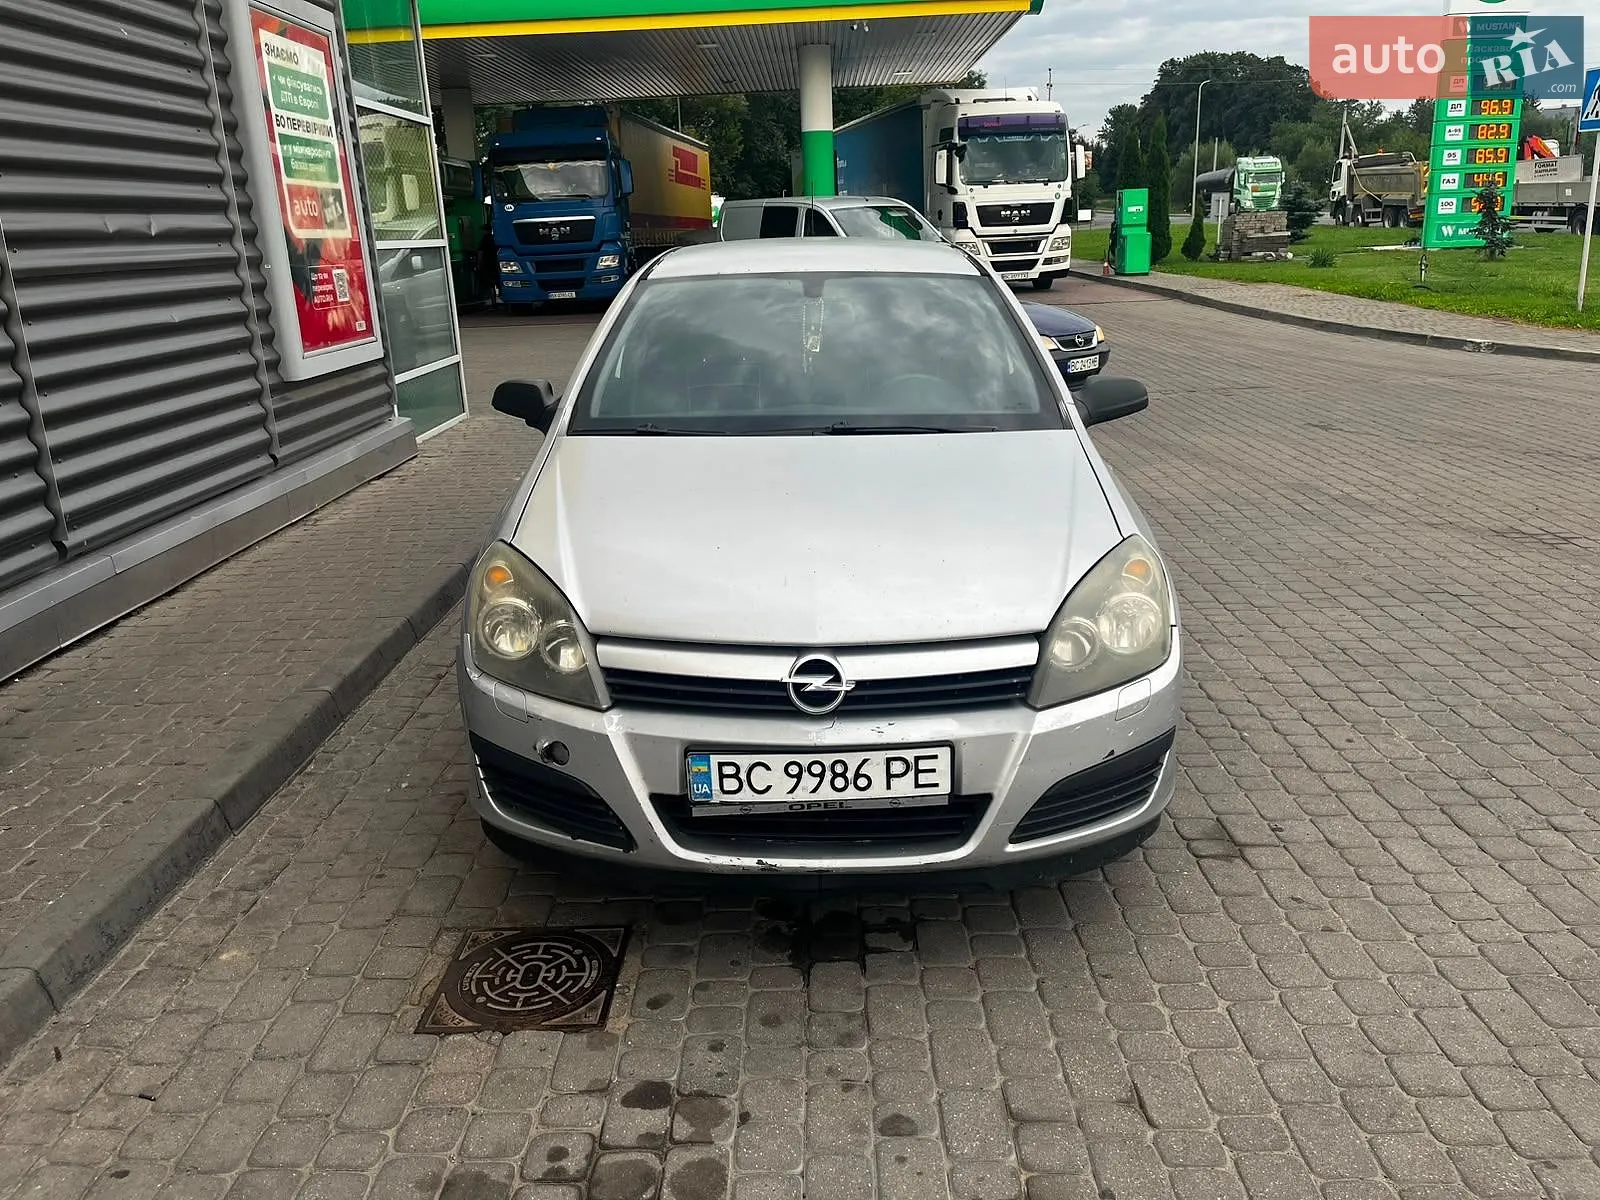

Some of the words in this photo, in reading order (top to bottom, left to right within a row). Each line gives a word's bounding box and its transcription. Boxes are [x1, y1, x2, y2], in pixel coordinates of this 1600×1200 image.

[264, 42, 299, 65] ЗНАЄМО
[1480, 99, 1512, 115] 96.9
[1477, 123, 1510, 139] 82.9
[293, 196, 318, 217] auto
[717, 761, 773, 795] BC
[783, 758, 873, 795] 9986
[885, 754, 940, 791] PE
[693, 783, 711, 794] UA
[788, 801, 852, 812] OPEL
